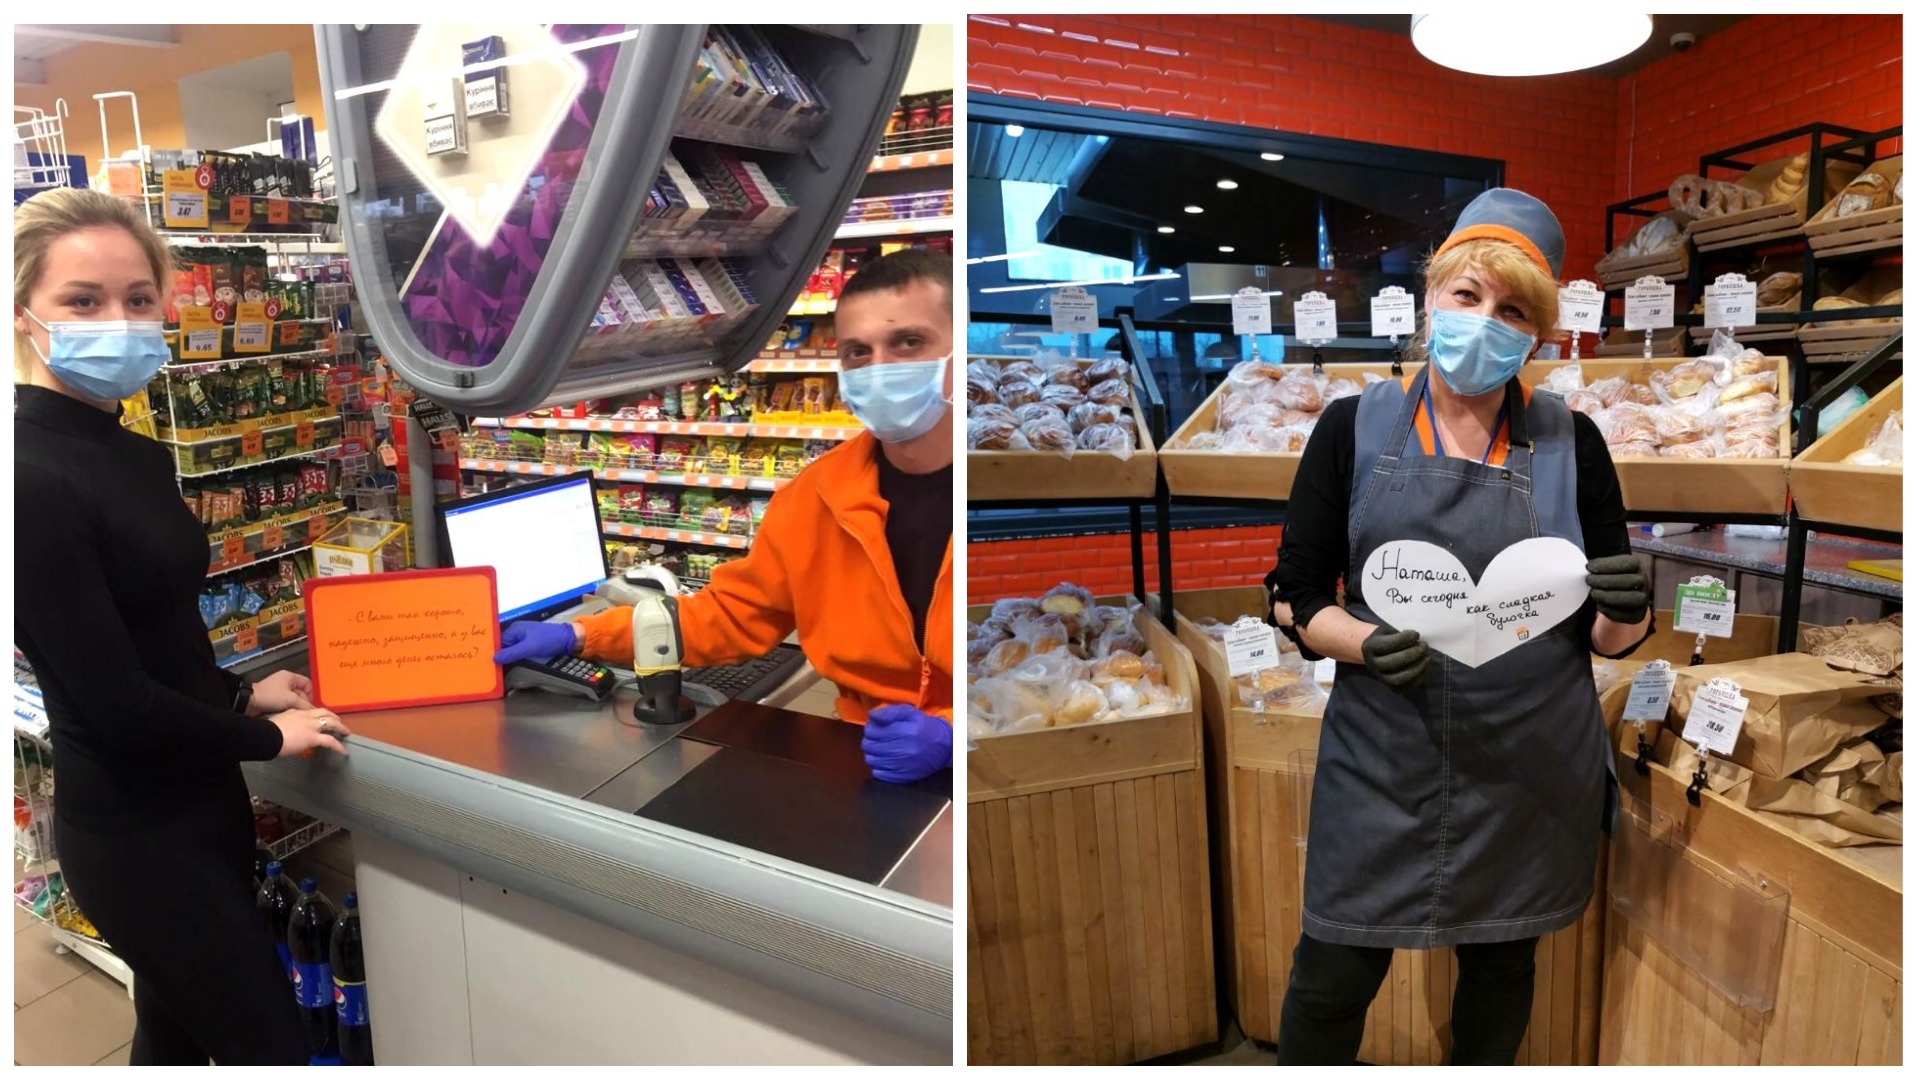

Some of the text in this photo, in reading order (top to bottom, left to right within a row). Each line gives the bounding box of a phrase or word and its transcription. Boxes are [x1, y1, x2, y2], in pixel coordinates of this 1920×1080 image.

[257, 417, 282, 427] JACOBS
[420, 412, 455, 427] HALLS
[204, 427, 232, 438] JACOBS
[1371, 547, 1467, 582] Наташа,
[1386, 587, 1469, 608] Вы сегодня
[1466, 589, 1556, 615] как сладкая
[270, 603, 298, 618] JACOBS
[1486, 609, 1540, 630] булочка
[219, 621, 250, 638] JACOBS
[471, 625, 487, 636] вас
